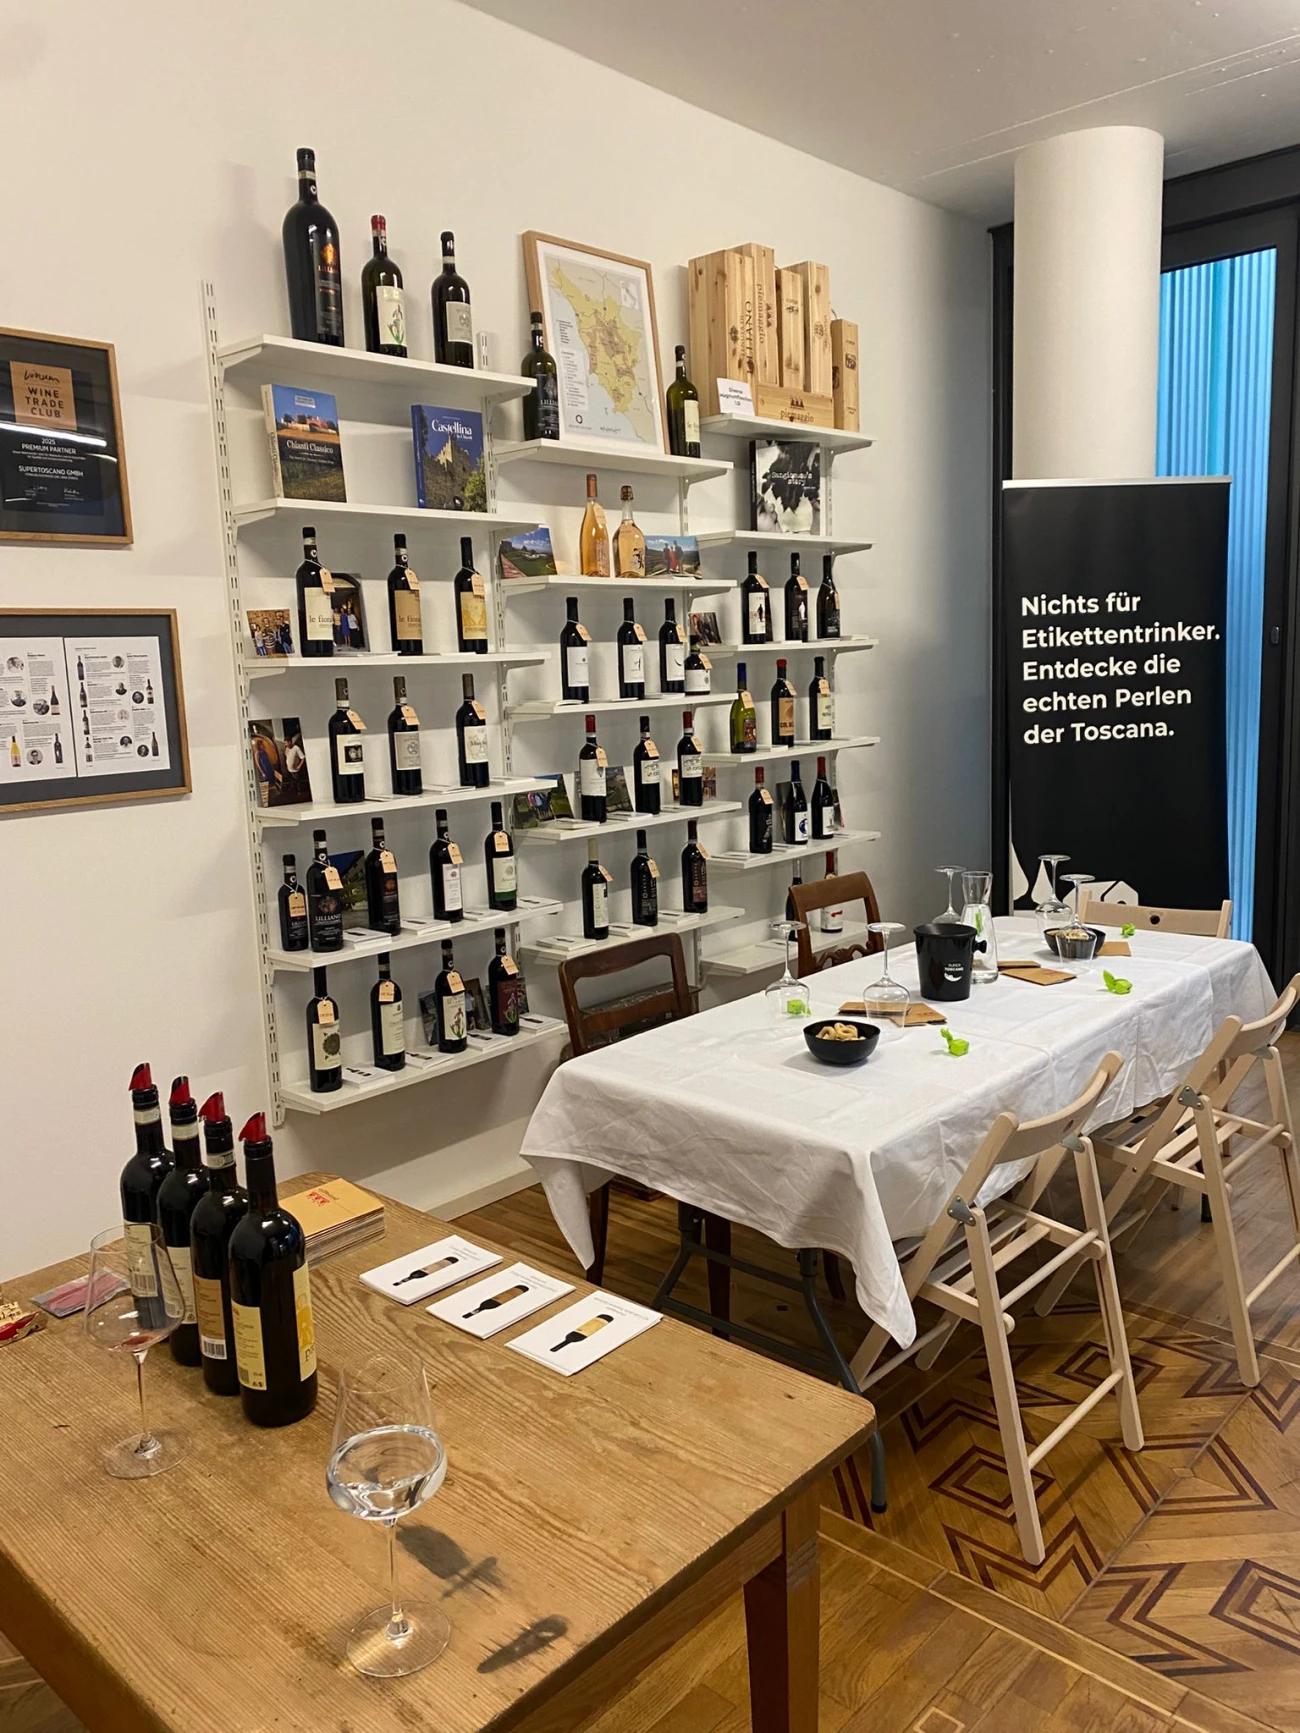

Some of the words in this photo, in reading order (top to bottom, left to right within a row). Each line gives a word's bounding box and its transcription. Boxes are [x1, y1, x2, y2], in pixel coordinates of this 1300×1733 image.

[745, 301, 753, 375] LLLIANO
[27, 386, 59, 398] WINE
[25, 396, 64, 409] TRADE
[31, 407, 61, 418] CLUB
[431, 419, 472, 435] Castellina
[21, 443, 49, 452] PREMIUM
[49, 446, 77, 455] PARTNER
[18, 465, 66, 475] SUPERTOSCANO
[1021, 594, 1099, 616] Nichts
[1106, 592, 1141, 613] für
[1022, 621, 1221, 648] Etikettentrinker.
[1023, 656, 1137, 681] Entdecke
[1144, 653, 1181, 675] die
[1022, 691, 1107, 713] echten
[1115, 685, 1192, 708] Perlen
[1023, 724, 1065, 744] der
[1070, 721, 1175, 742] Toscana.
